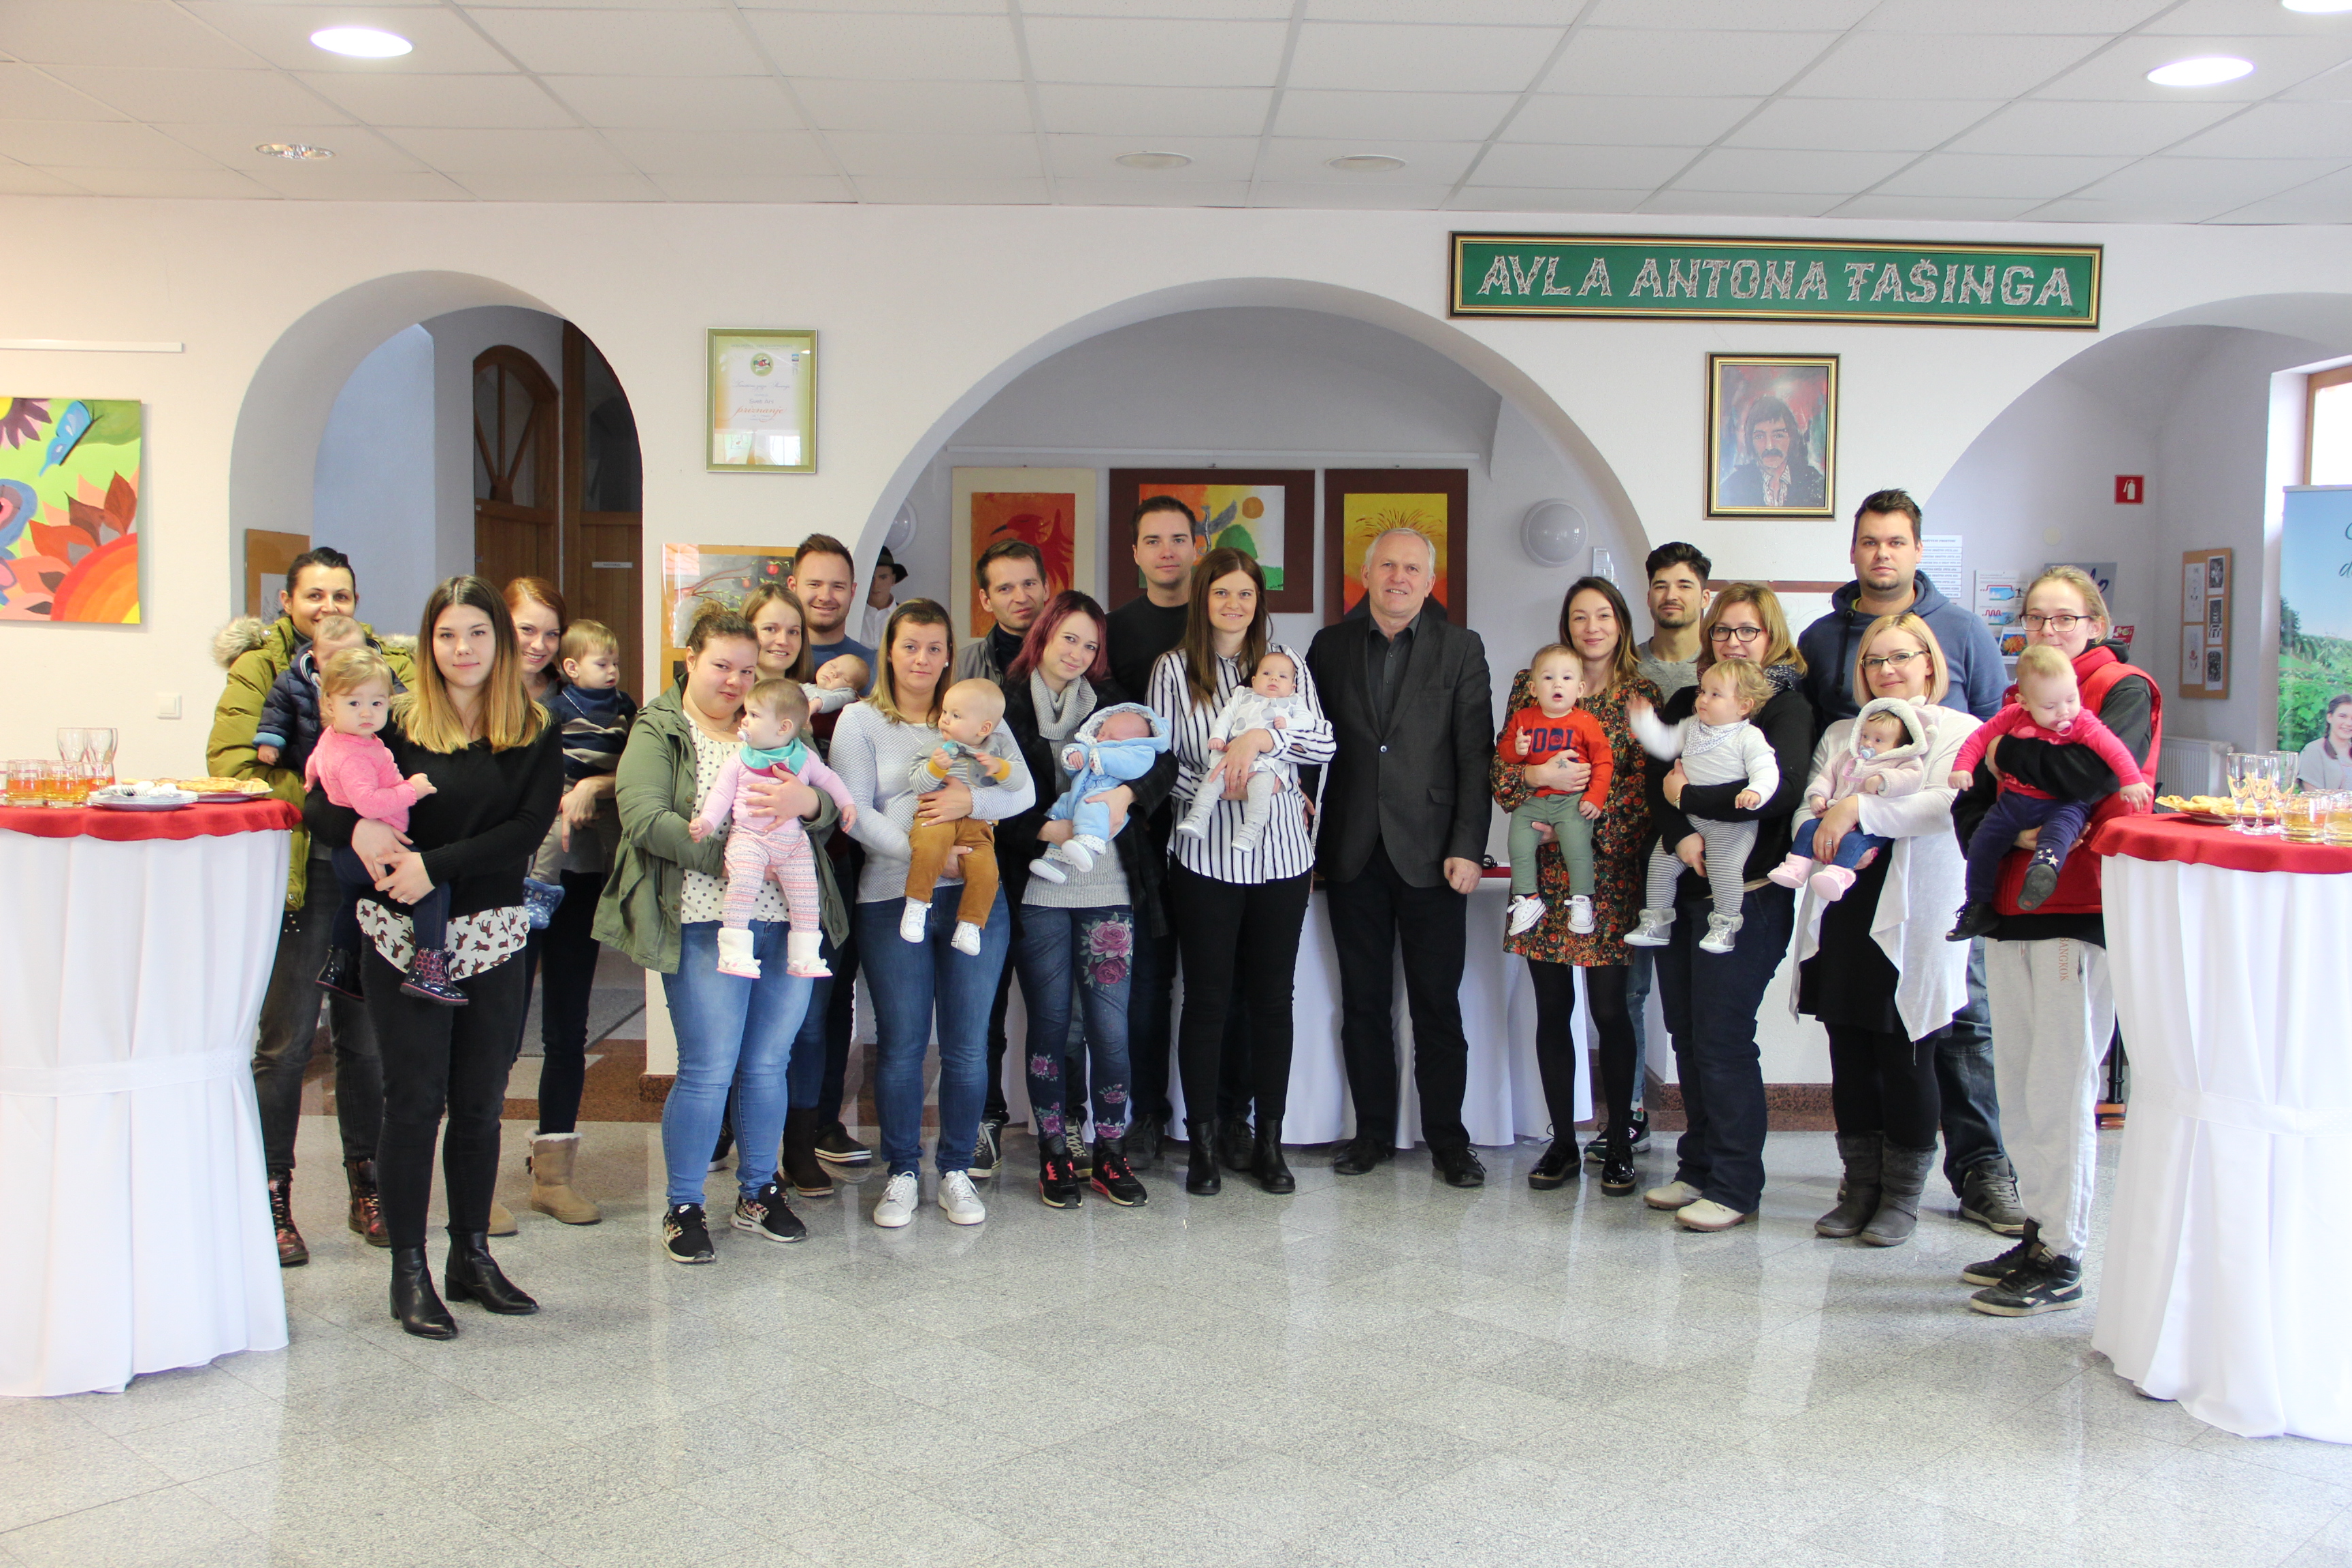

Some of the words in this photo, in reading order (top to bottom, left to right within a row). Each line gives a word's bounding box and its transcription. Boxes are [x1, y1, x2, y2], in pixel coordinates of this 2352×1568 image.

[1628, 258, 1829, 300] ANTONA
[1844, 259, 2074, 306] TAŠINGA
[724, 406, 784, 421] priznanje
[2059, 937, 2070, 982] BANGKOK
